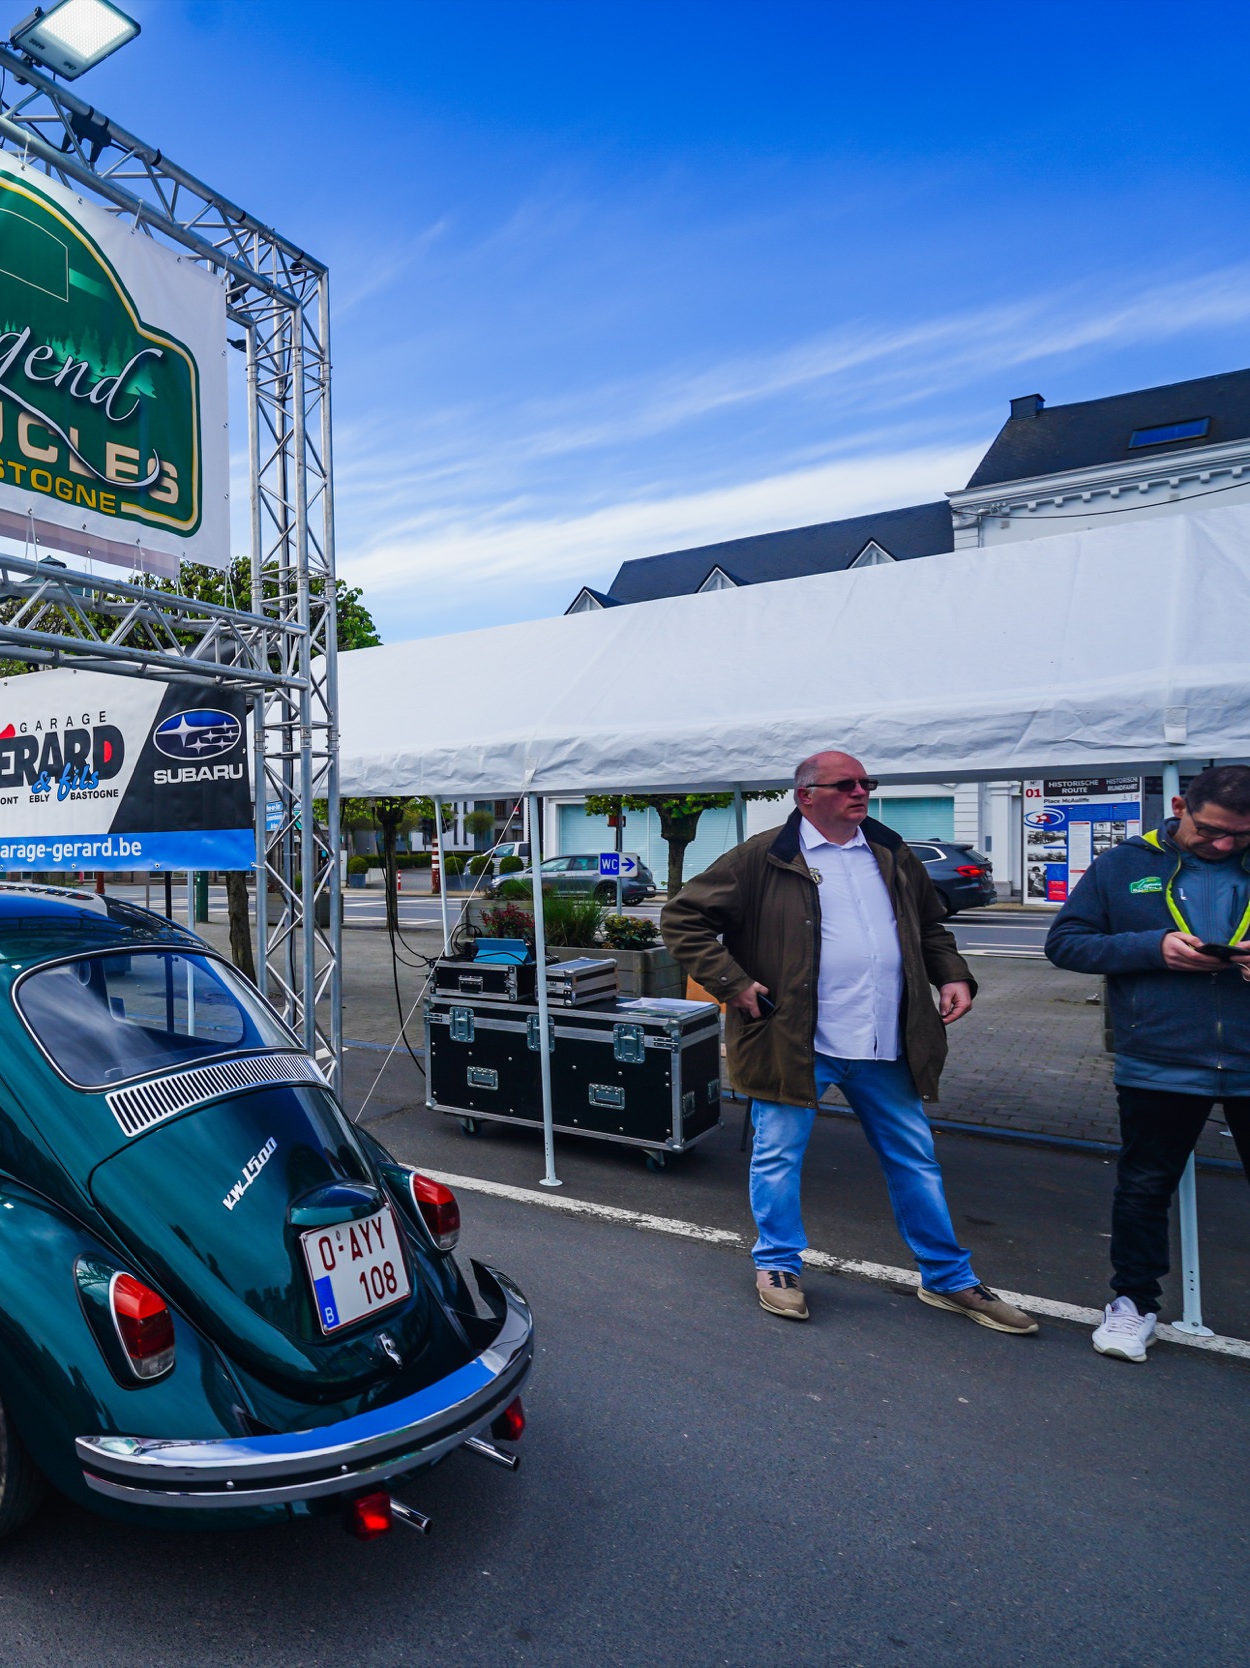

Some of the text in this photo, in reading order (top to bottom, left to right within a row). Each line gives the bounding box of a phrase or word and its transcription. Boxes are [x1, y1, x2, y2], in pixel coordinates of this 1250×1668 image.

[20, 710, 107, 733] GARAGE
[31, 762, 100, 801] & fils
[154, 763, 243, 785] SUBARU
[1048, 779, 1099, 788] HISTORISCHE
[29, 793, 50, 804] EBLY
[70, 789, 119, 801] BASTOGNE
[1025, 788, 1042, 798] 01
[601, 858, 618, 871] WC
[359, 1260, 398, 1305] 108
[326, 1307, 335, 1323] B
